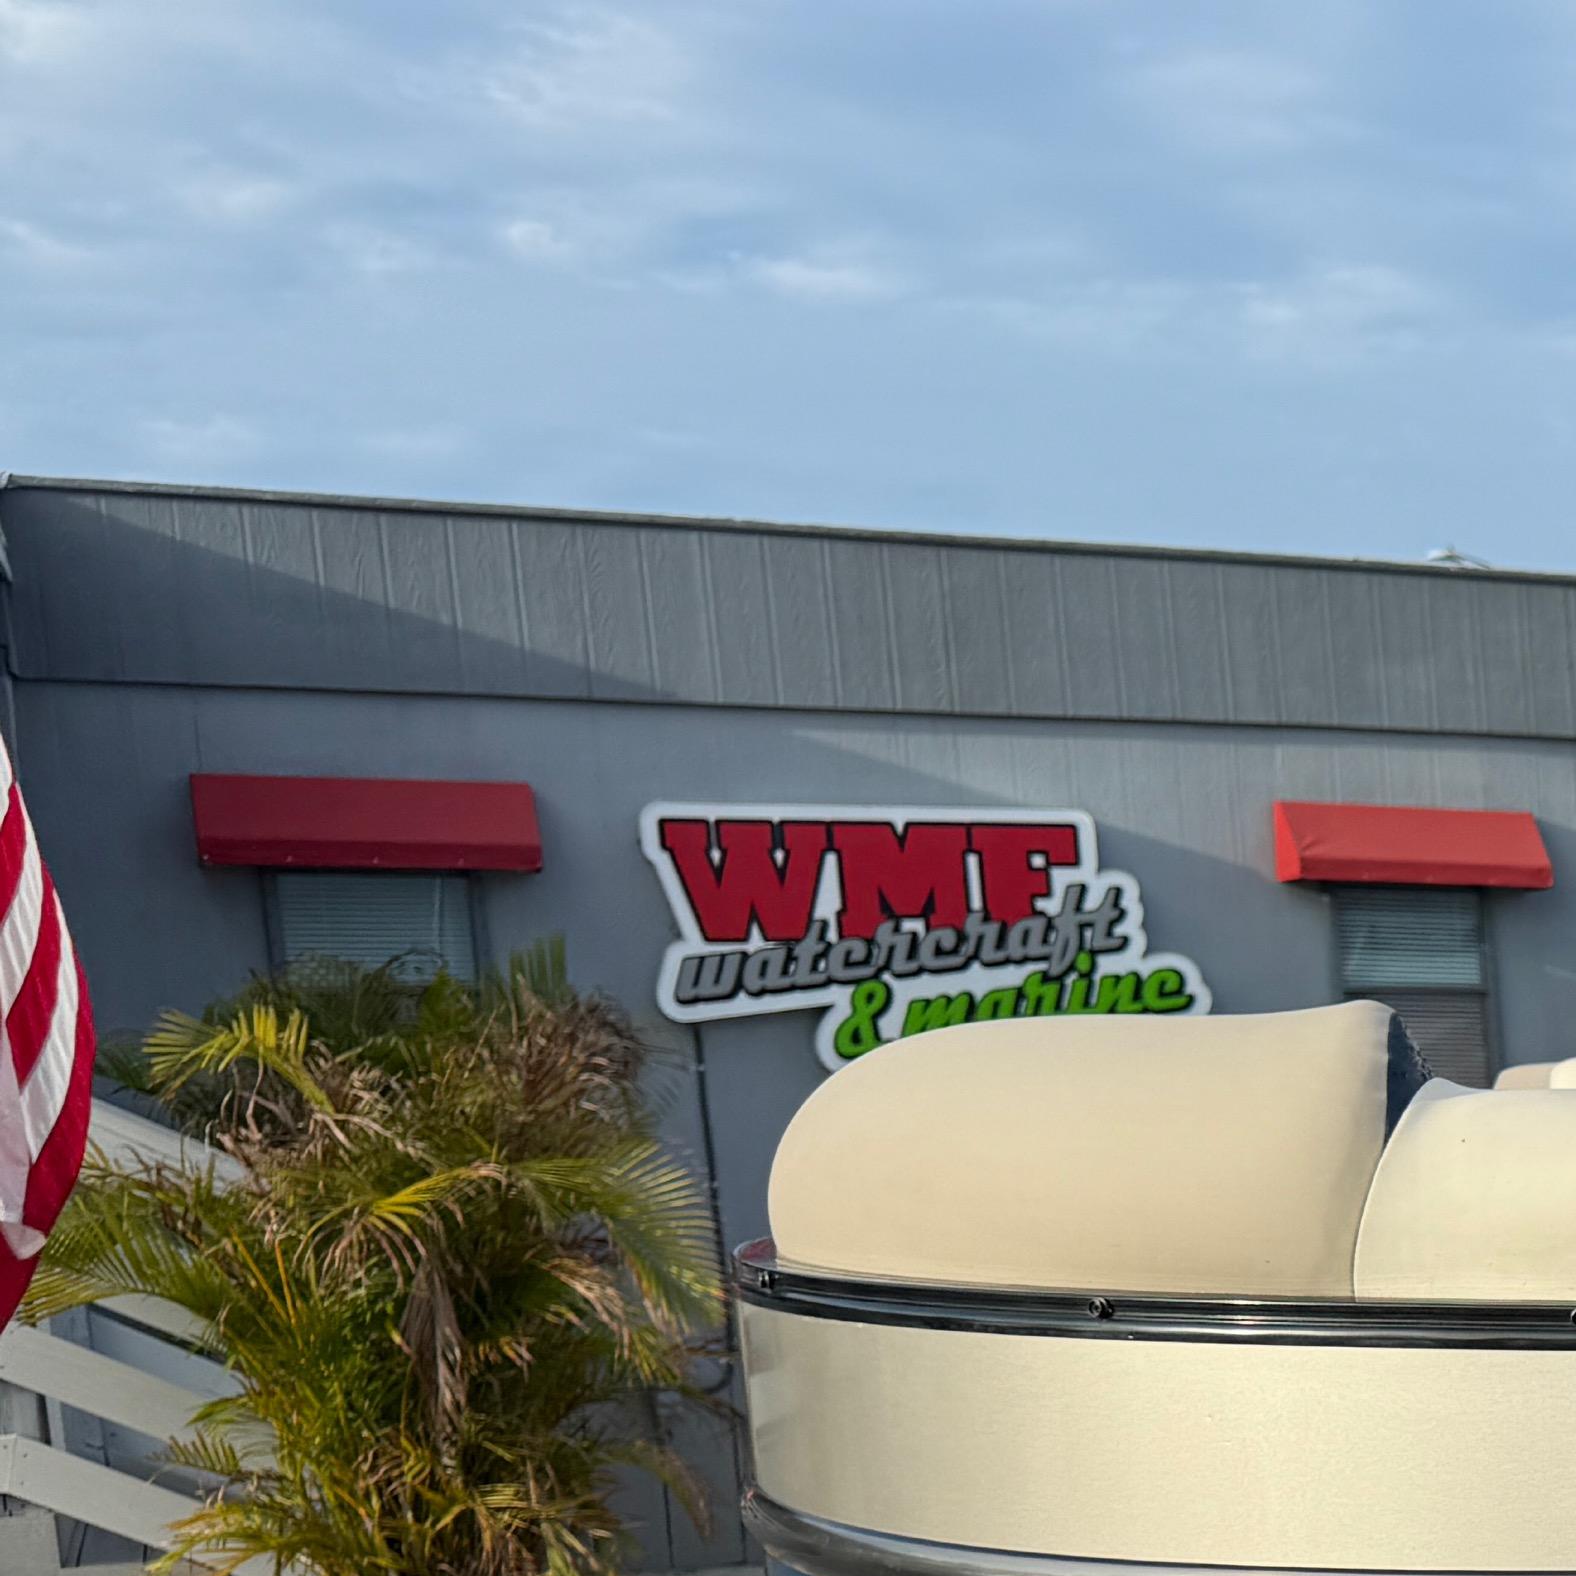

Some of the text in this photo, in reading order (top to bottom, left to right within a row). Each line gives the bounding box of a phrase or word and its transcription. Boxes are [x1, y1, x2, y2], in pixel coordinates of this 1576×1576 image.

[659, 818, 1079, 943] WMF
[674, 883, 1129, 1003] watercraft
[833, 951, 1194, 1061] & marine
